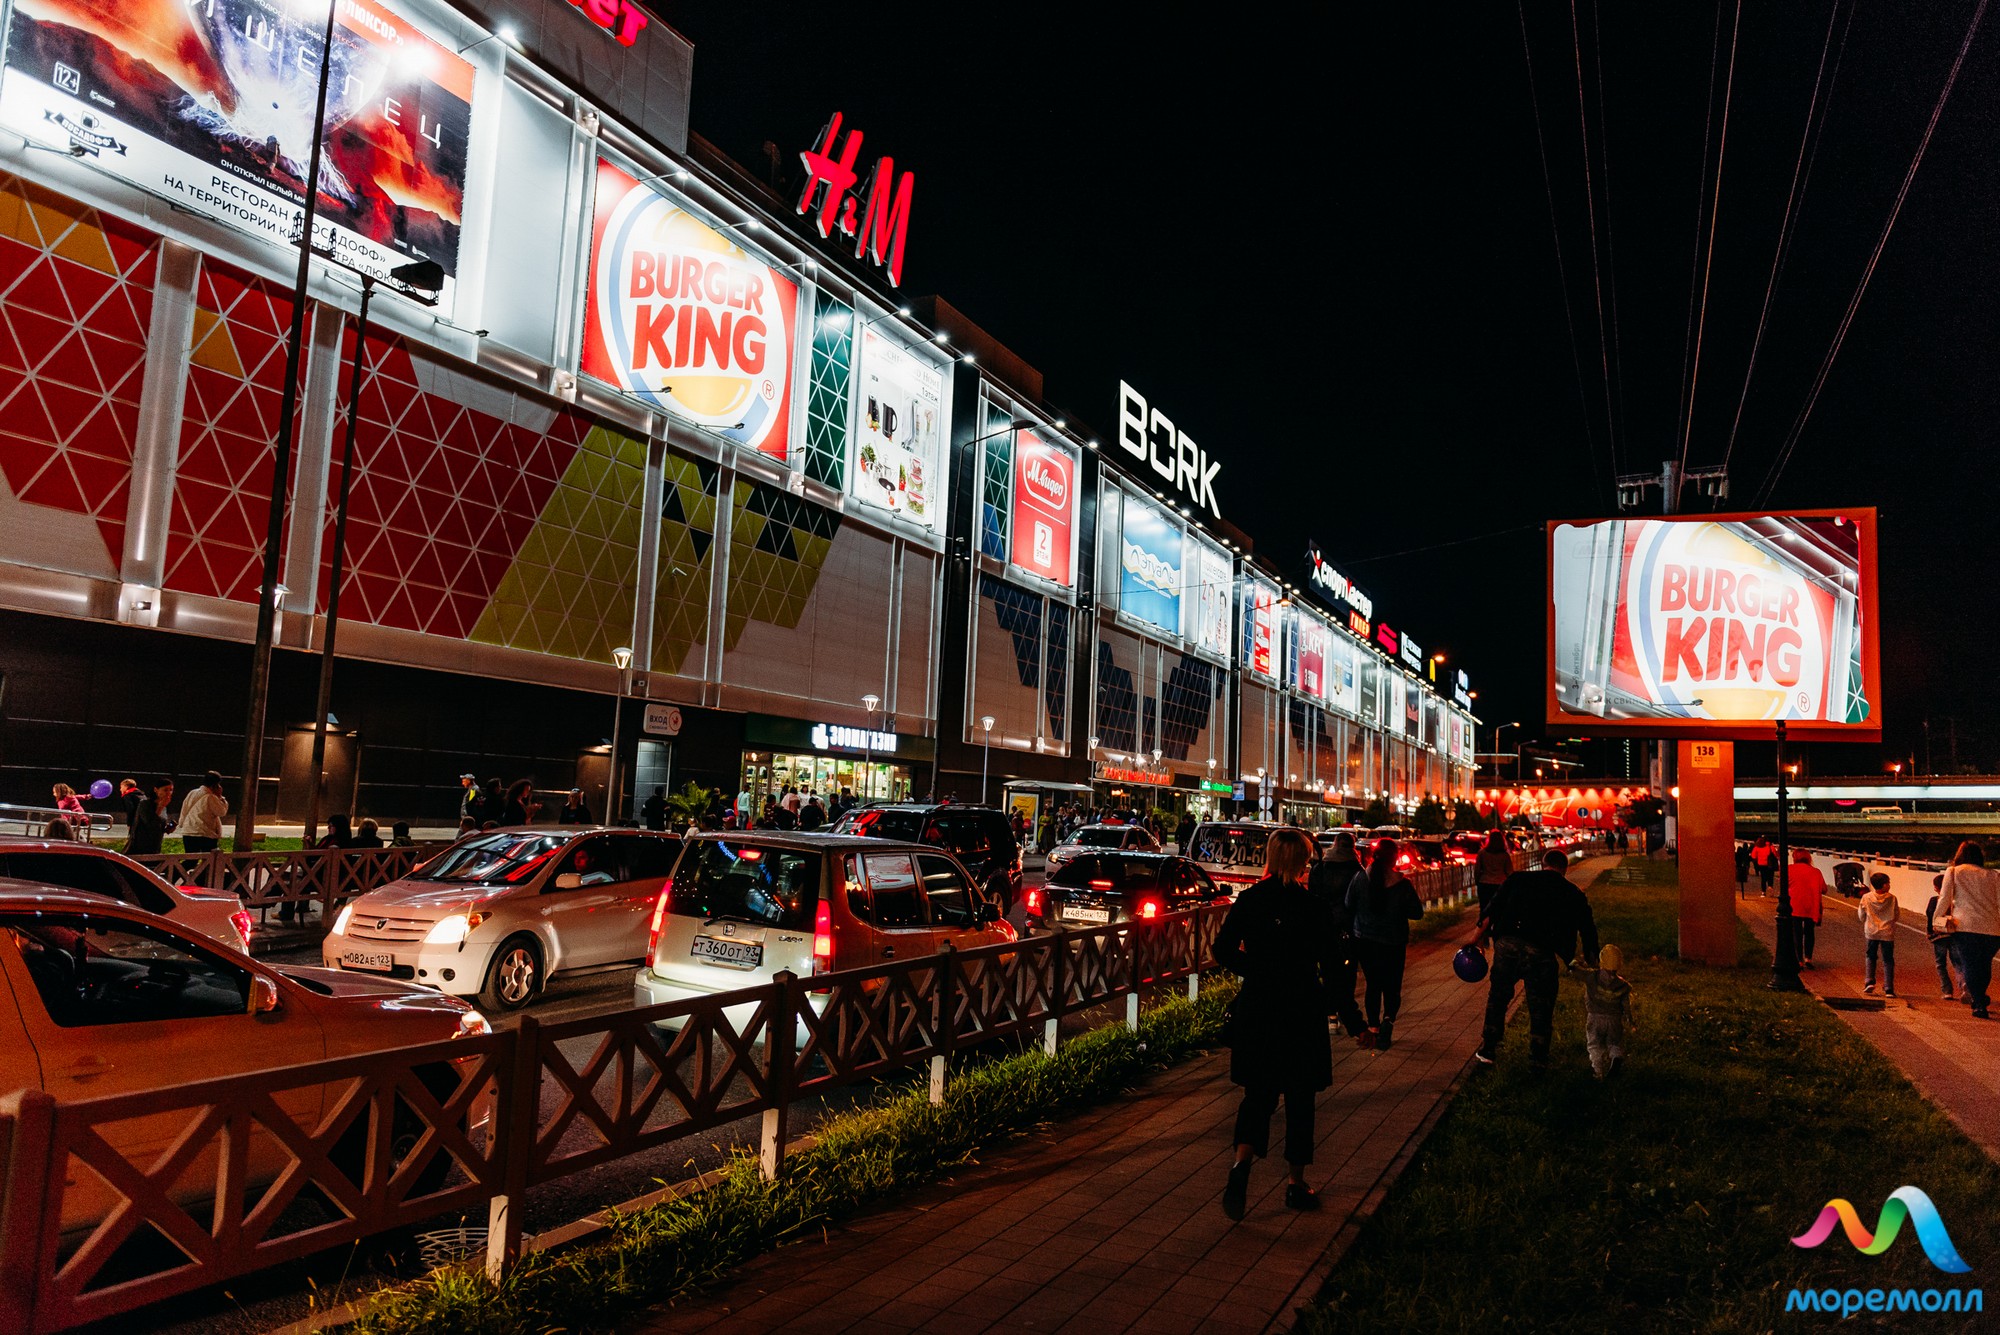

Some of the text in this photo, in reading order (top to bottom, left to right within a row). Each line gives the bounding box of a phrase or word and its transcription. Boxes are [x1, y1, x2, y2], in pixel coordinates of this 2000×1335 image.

[57, 65, 78, 89] 12+
[164, 174, 185, 193] НА
[189, 184, 276, 233] ТЕРРИТОРИИ
[221, 159, 307, 205] ОН ОТКРЫЛ ЦЕЛЫЙ МИ
[797, 111, 914, 287] H&M
[211, 175, 386, 262] РЕСТОРАН ОСДОФФ»
[629, 250, 764, 316] BURGER
[631, 304, 767, 375] KING
[1119, 379, 1222, 520] BORK
[1040, 529, 1047, 551] 2
[1660, 564, 1800, 627] BURGER
[1308, 631, 1323, 658] KFC
[1661, 616, 1803, 688] KING
[650, 714, 668, 726] ВХОД
[829, 725, 898, 752] ЗООМАГАЗИН
[1696, 746, 1715, 756] 138
[344, 952, 390, 966] М082АЕ 123
[698, 940, 757, 958] Т360ОТ 93
